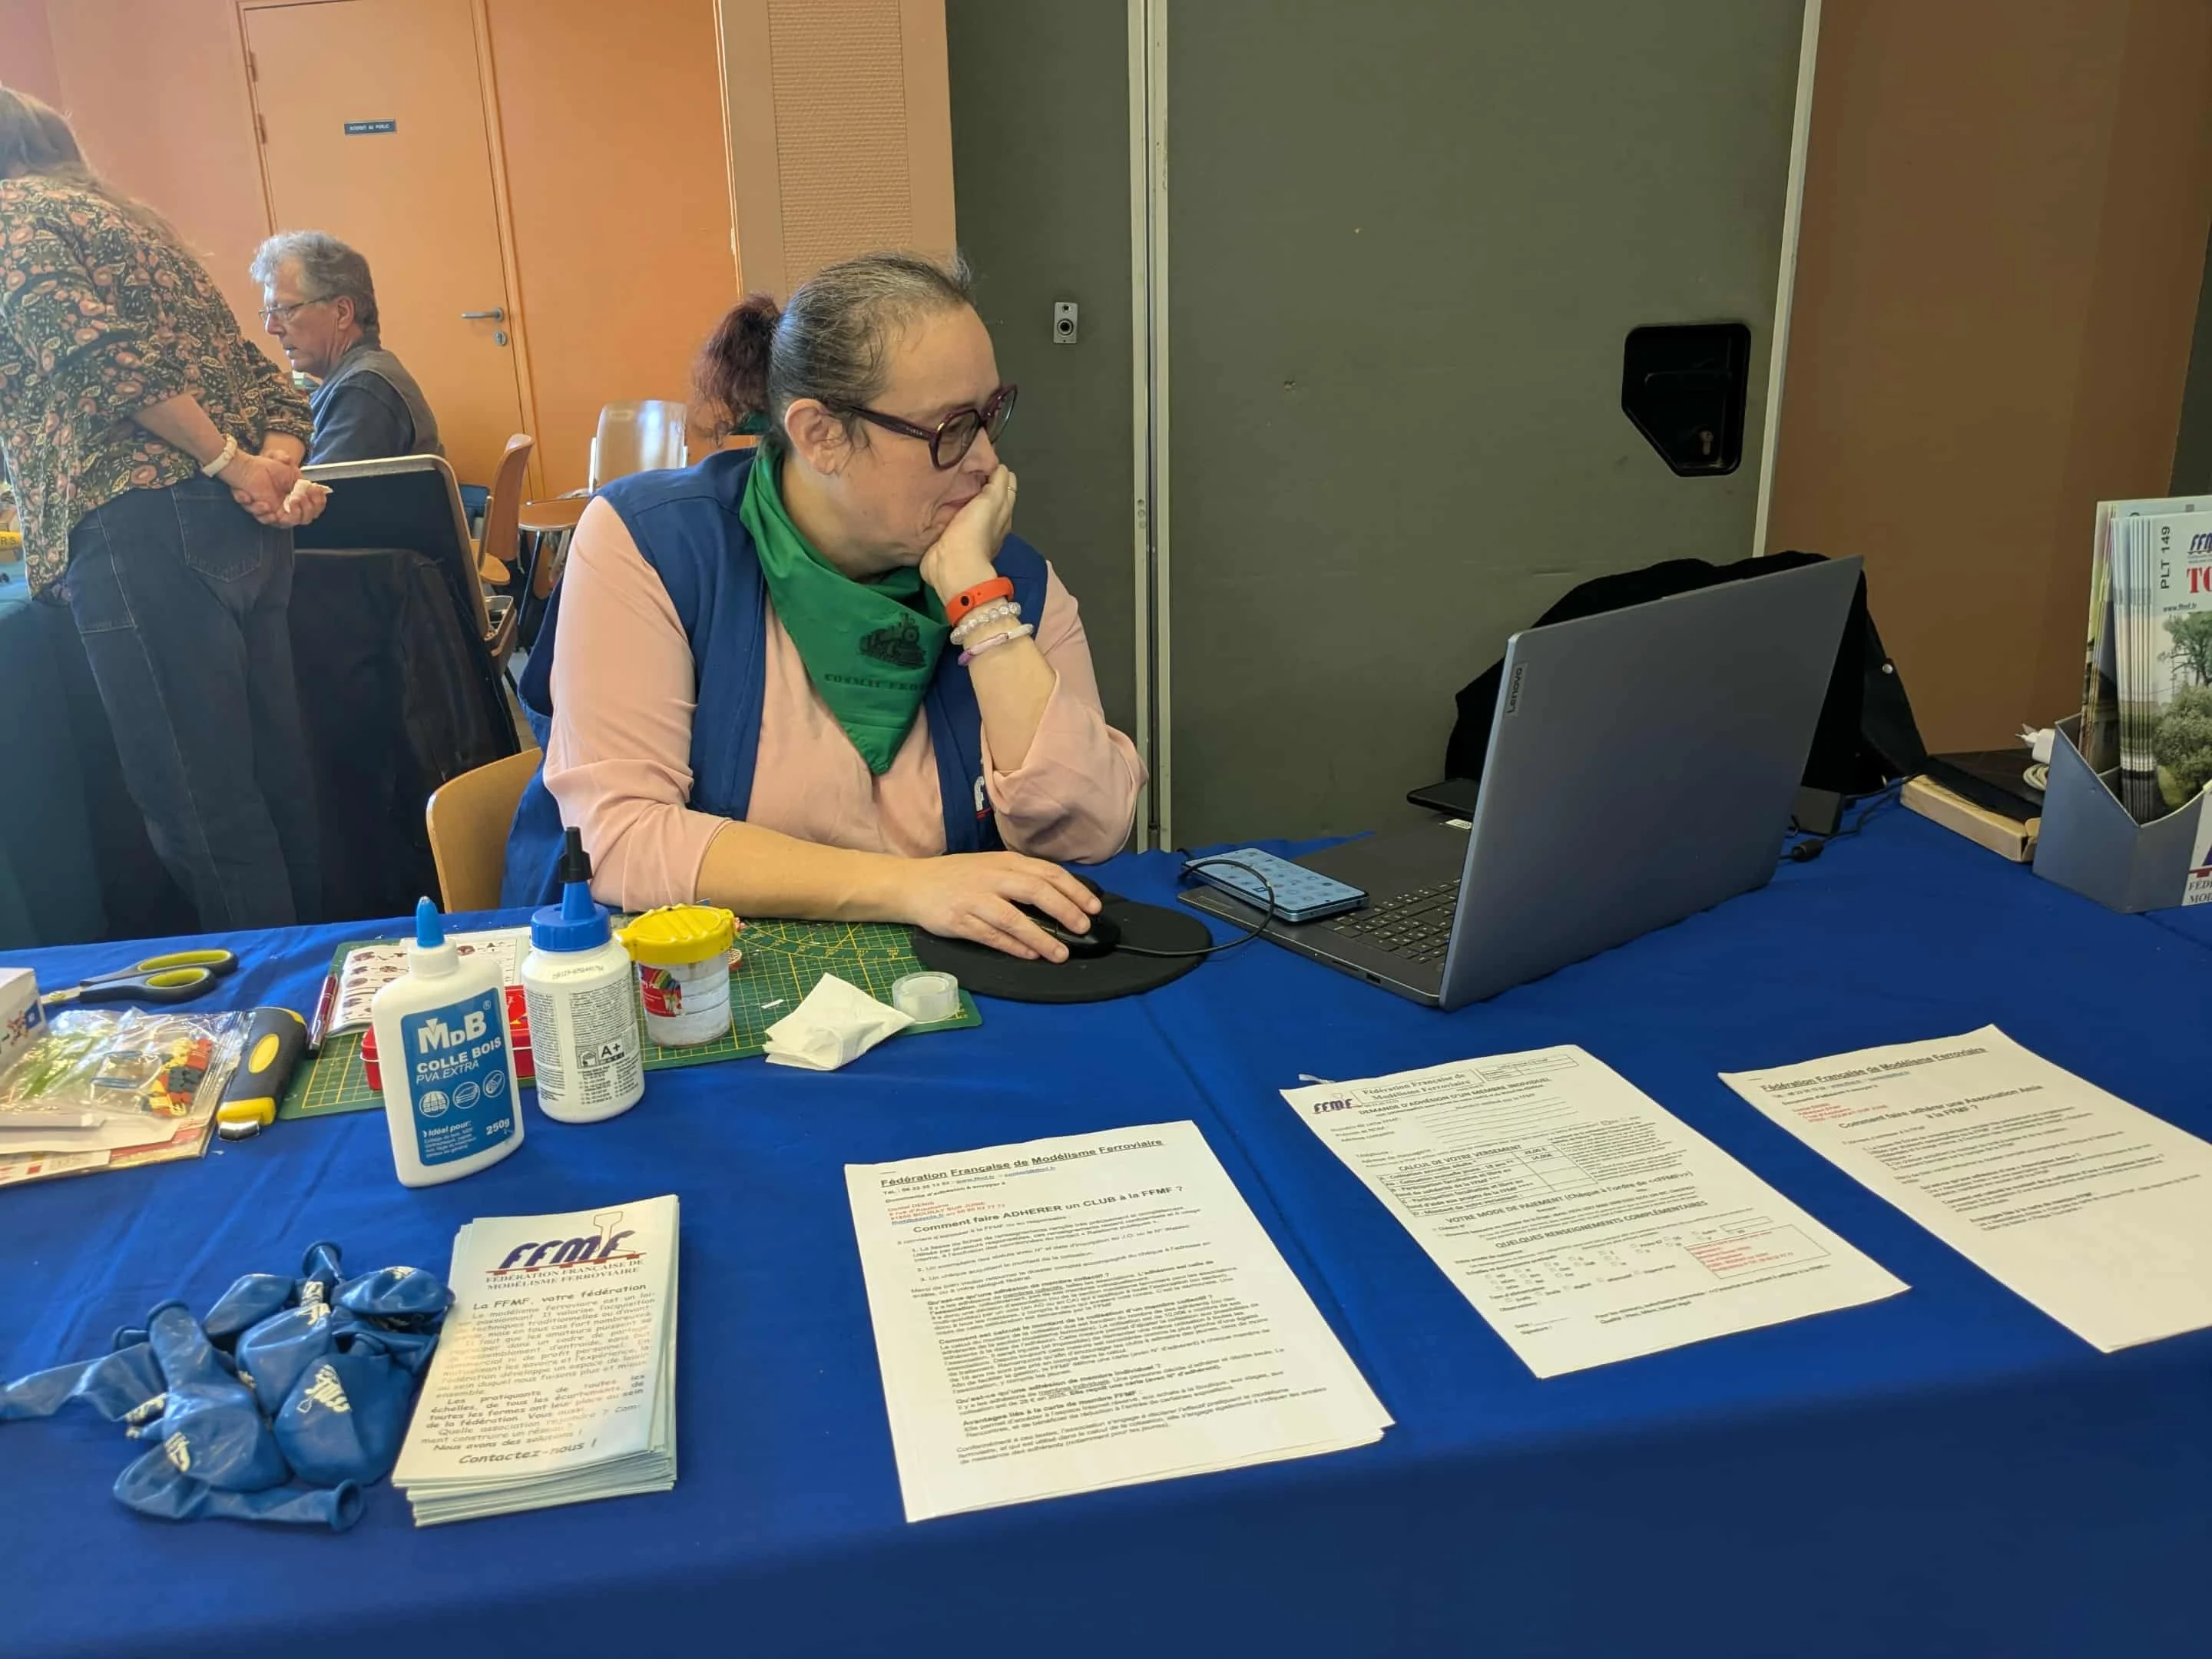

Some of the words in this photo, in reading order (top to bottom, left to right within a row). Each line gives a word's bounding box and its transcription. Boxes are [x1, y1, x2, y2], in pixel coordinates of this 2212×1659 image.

[2161, 526, 2171, 554] 149
[2161, 560, 2170, 589] PLT
[1507, 668, 1522, 713] Lenovo
[416, 1052, 468, 1073] COLLE
[472, 1038, 502, 1060] BOIS
[1760, 1078, 1816, 1091] Fédération
[1816, 1069, 1866, 1084] Française
[1866, 1066, 1880, 1075] de
[1880, 1056, 1932, 1069] Modélisme
[1932, 1047, 1986, 1059] Ferroviaire
[1359, 1105, 1399, 1115] DEMANDE
[1473, 1085, 1505, 1094] MEMBRE
[1363, 1084, 1409, 1097] Fédération
[1314, 1099, 1353, 1114] FFMF
[1839, 1114, 1886, 1128] Comment
[1886, 1111, 1908, 1119] faire
[1965, 1090, 2018, 1103] Association
[1944, 1106, 1969, 1115] FFMF
[486, 1118, 510, 1135] 250g
[881, 1171, 946, 1187] Fédération
[951, 1161, 1012, 1176] Française
[1013, 1159, 1029, 1167] de
[1031, 1148, 1098, 1164] Modélisme
[1099, 1139, 1164, 1154] Ferroviaire
[1399, 1161, 1430, 1171] CALCUL
[1444, 1153, 1471, 1162] VOTRE
[1473, 1144, 1522, 1157] VERSEMENT
[914, 1218, 971, 1233] Comment
[974, 1214, 1000, 1224] faire
[1003, 1204, 1062, 1219] ADHERER
[1065, 1202, 1081, 1210] un
[1083, 1196, 1117, 1207] CLUB
[1141, 1186, 1175, 1197] FFMF
[1445, 1214, 1476, 1223] VOTRE
[1478, 1208, 1505, 1218] MODE
[1518, 1198, 1563, 1210] PAIEMENT
[1495, 1232, 1545, 1249] QUELQUES
[1545, 1218, 1623, 1237] RENSEIGNEMENTS
[498, 1230, 636, 1270] FFMF
[630, 1259, 644, 1267] DE
[561, 1267, 638, 1282] FERROVIAIRE
[474, 1301, 488, 1310] La
[542, 1293, 574, 1303] votre
[582, 1283, 647, 1298] fédération
[480, 1390, 541, 1403] pratiquants
[584, 1379, 617, 1389] toutes
[1114, 1390, 1136, 1399] FFMF
[430, 1412, 463, 1421] toutes
[488, 1407, 525, 1417] formes
[551, 1401, 572, 1409] leur
[576, 1397, 602, 1408] place
[622, 1389, 644, 1397] sein
[439, 1427, 474, 1436] Quelle
[480, 1420, 541, 1433] association
[452, 1432, 510, 1443] construire
[459, 1442, 584, 1465] Contactez-nous
[591, 1438, 598, 1448] !
[467, 1442, 497, 1450] avons
[502, 1439, 522, 1447] des
